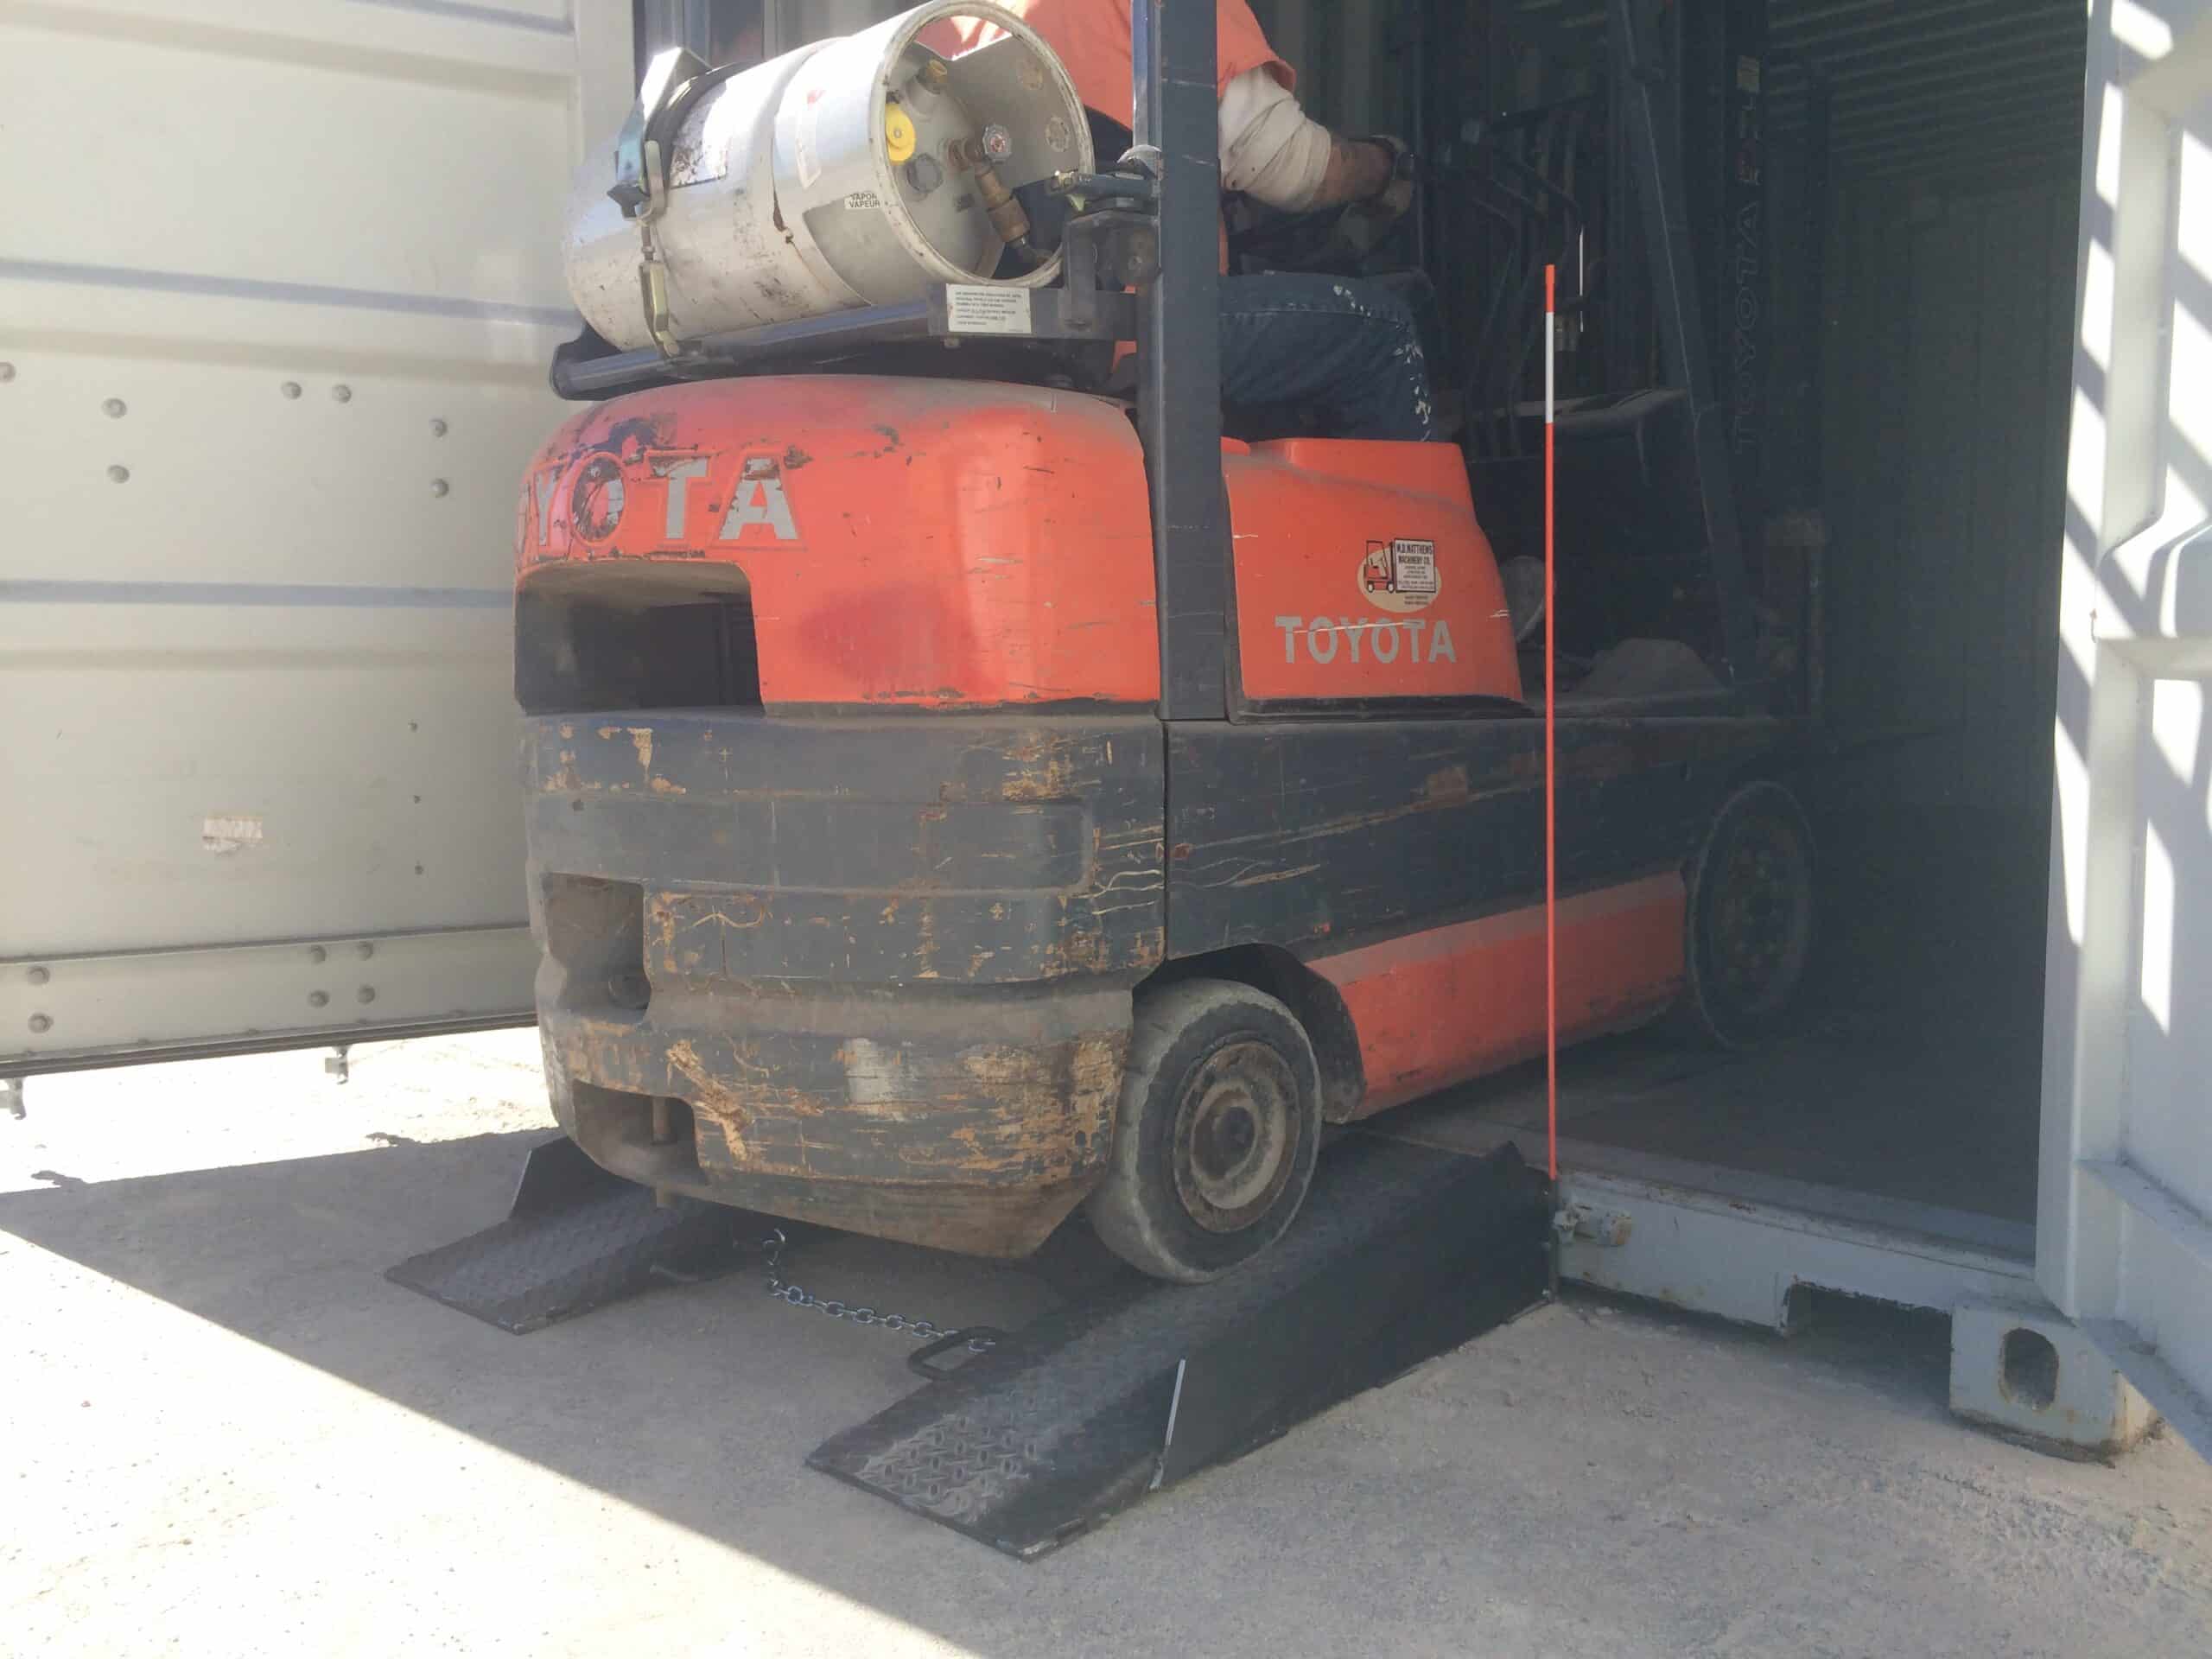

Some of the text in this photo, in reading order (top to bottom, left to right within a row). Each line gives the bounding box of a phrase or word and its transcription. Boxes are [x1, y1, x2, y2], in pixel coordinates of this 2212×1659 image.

[849, 200, 880, 208] VAPEUR
[1734, 200, 1758, 454] TOYOTA
[1274, 615, 1457, 664] TOYOTA
